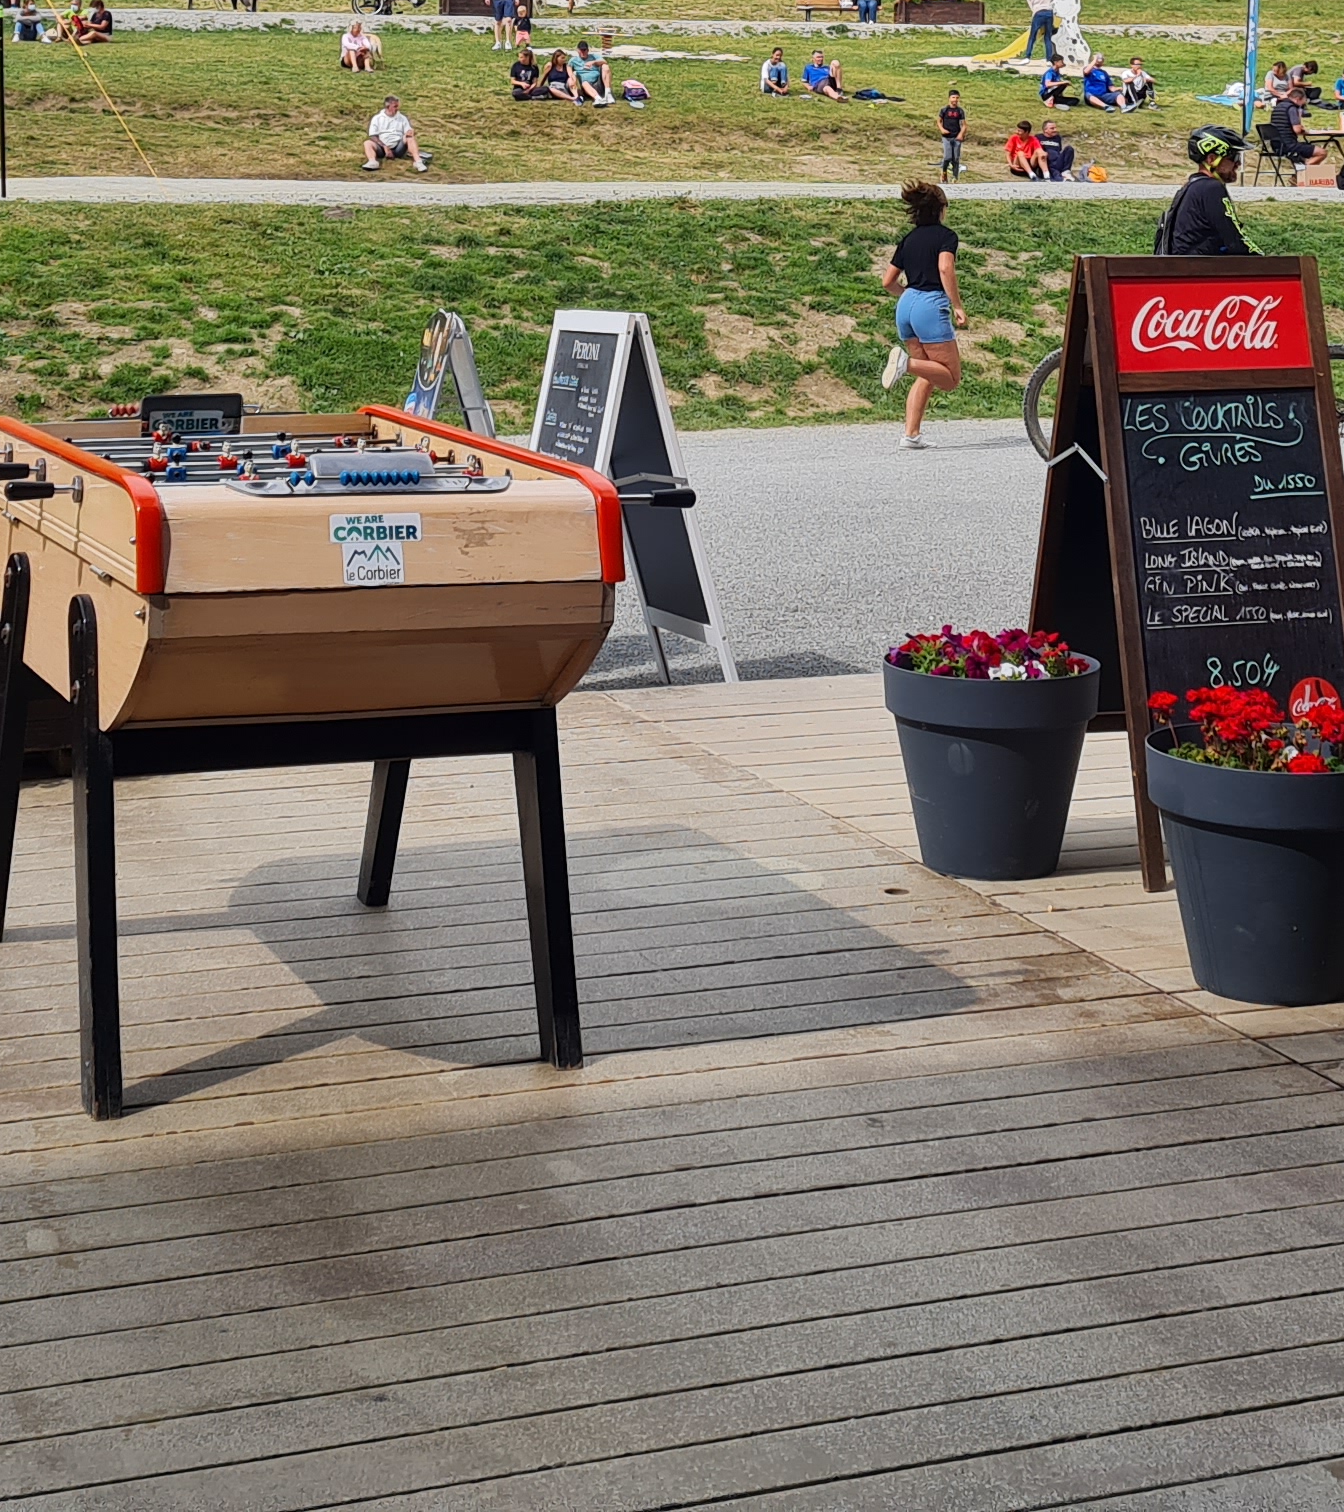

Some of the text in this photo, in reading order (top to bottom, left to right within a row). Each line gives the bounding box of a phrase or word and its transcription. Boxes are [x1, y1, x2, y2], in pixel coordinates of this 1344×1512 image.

[1131, 295, 1283, 353] Coca-Cola
[571, 339, 601, 361] PERONI
[1123, 399, 1169, 432] LES
[1277, 473, 1316, 489] 1550
[346, 515, 384, 525] WE ARE
[1140, 517, 1179, 538] BLUE
[334, 525, 418, 541] CORBIER
[1145, 552, 1177, 569] LONG
[1180, 547, 1230, 568] ISLAND
[346, 564, 402, 581] le Corbier
[1146, 605, 1164, 625] LE
[1236, 604, 1267, 621] 1550
